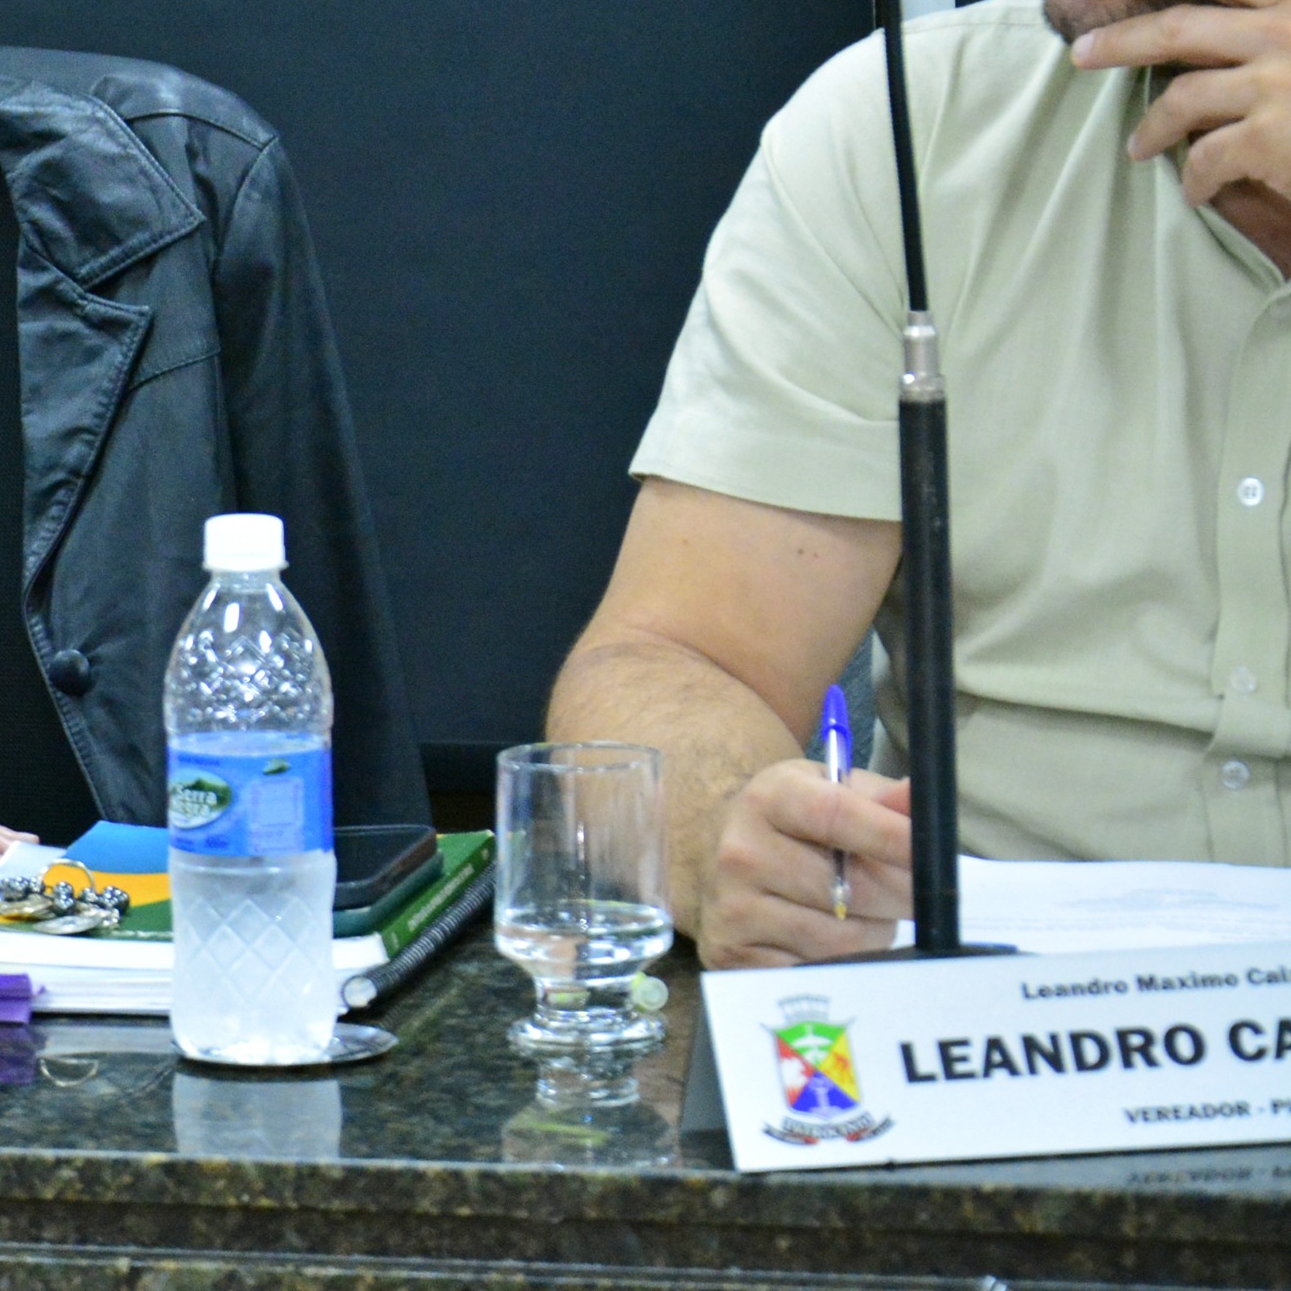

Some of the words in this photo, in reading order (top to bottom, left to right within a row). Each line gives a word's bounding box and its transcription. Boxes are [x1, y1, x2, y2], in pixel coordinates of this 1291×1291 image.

[1021, 977, 1129, 1001] Leandro
[1135, 969, 1240, 994] Maximo
[899, 1022, 1207, 1085] LEANDRO
[1125, 1099, 1252, 1124] VEREADOR
